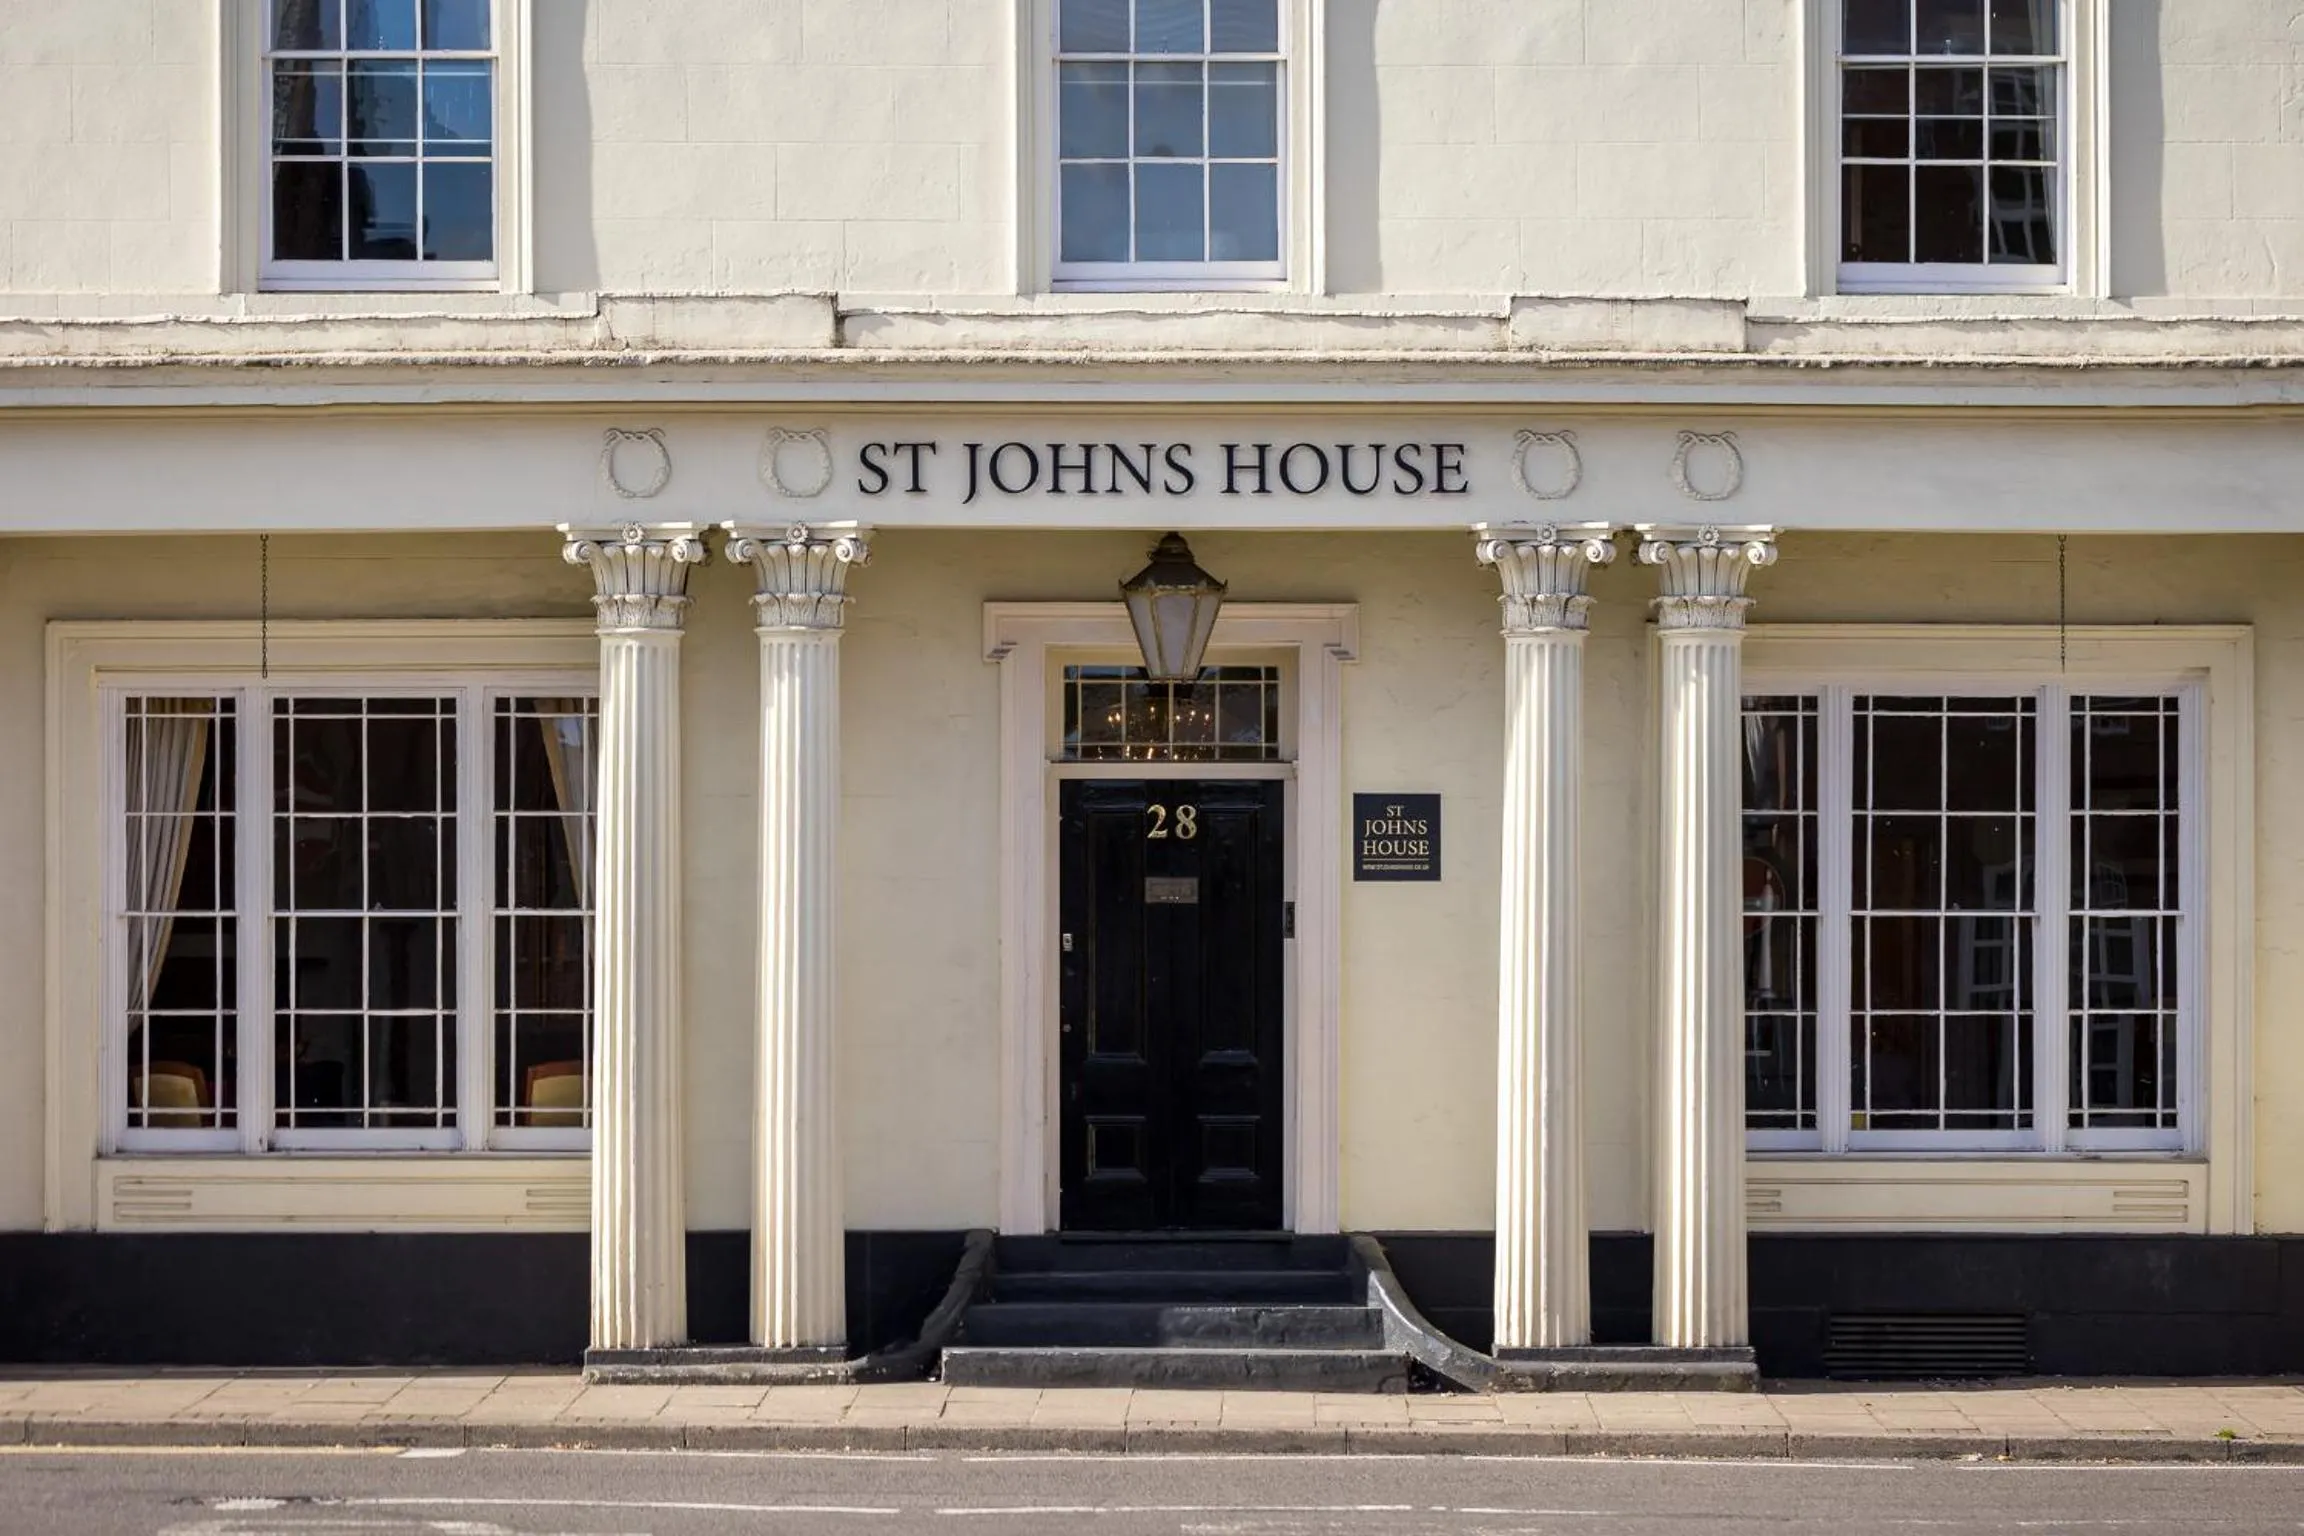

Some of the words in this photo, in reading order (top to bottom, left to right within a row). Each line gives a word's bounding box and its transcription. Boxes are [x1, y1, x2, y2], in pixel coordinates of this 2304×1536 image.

[857, 442, 936, 494] ST
[962, 441, 1195, 505] JOHNS
[1219, 442, 1469, 495] HOUSE
[1386, 805, 1404, 817] ST
[1147, 804, 1197, 839] 28
[1364, 819, 1428, 837] JOHNS
[1363, 839, 1429, 855] HOUSE
